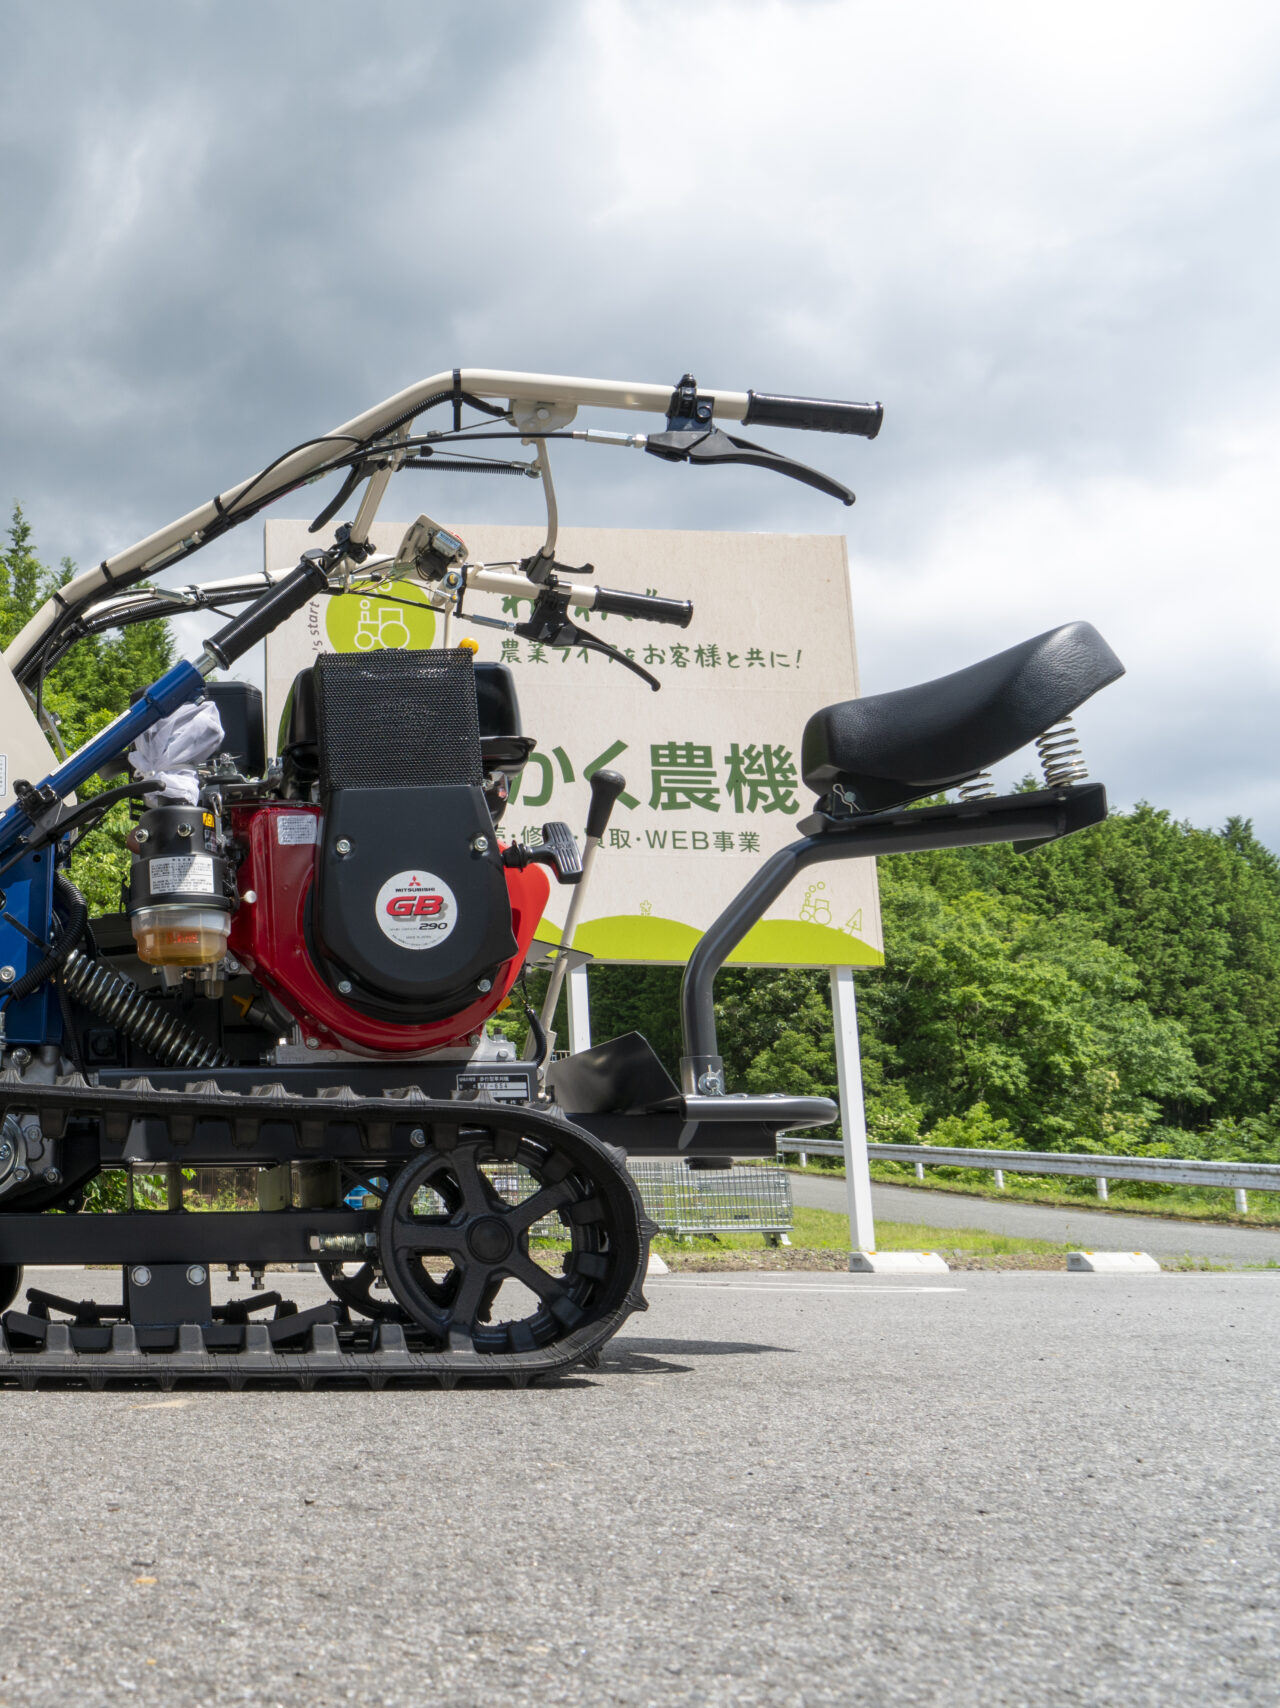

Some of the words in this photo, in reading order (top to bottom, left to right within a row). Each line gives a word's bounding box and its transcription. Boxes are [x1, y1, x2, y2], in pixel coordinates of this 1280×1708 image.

[307, 601, 320, 636] start
[386, 895, 445, 917] GB
[419, 922, 448, 931] 290
